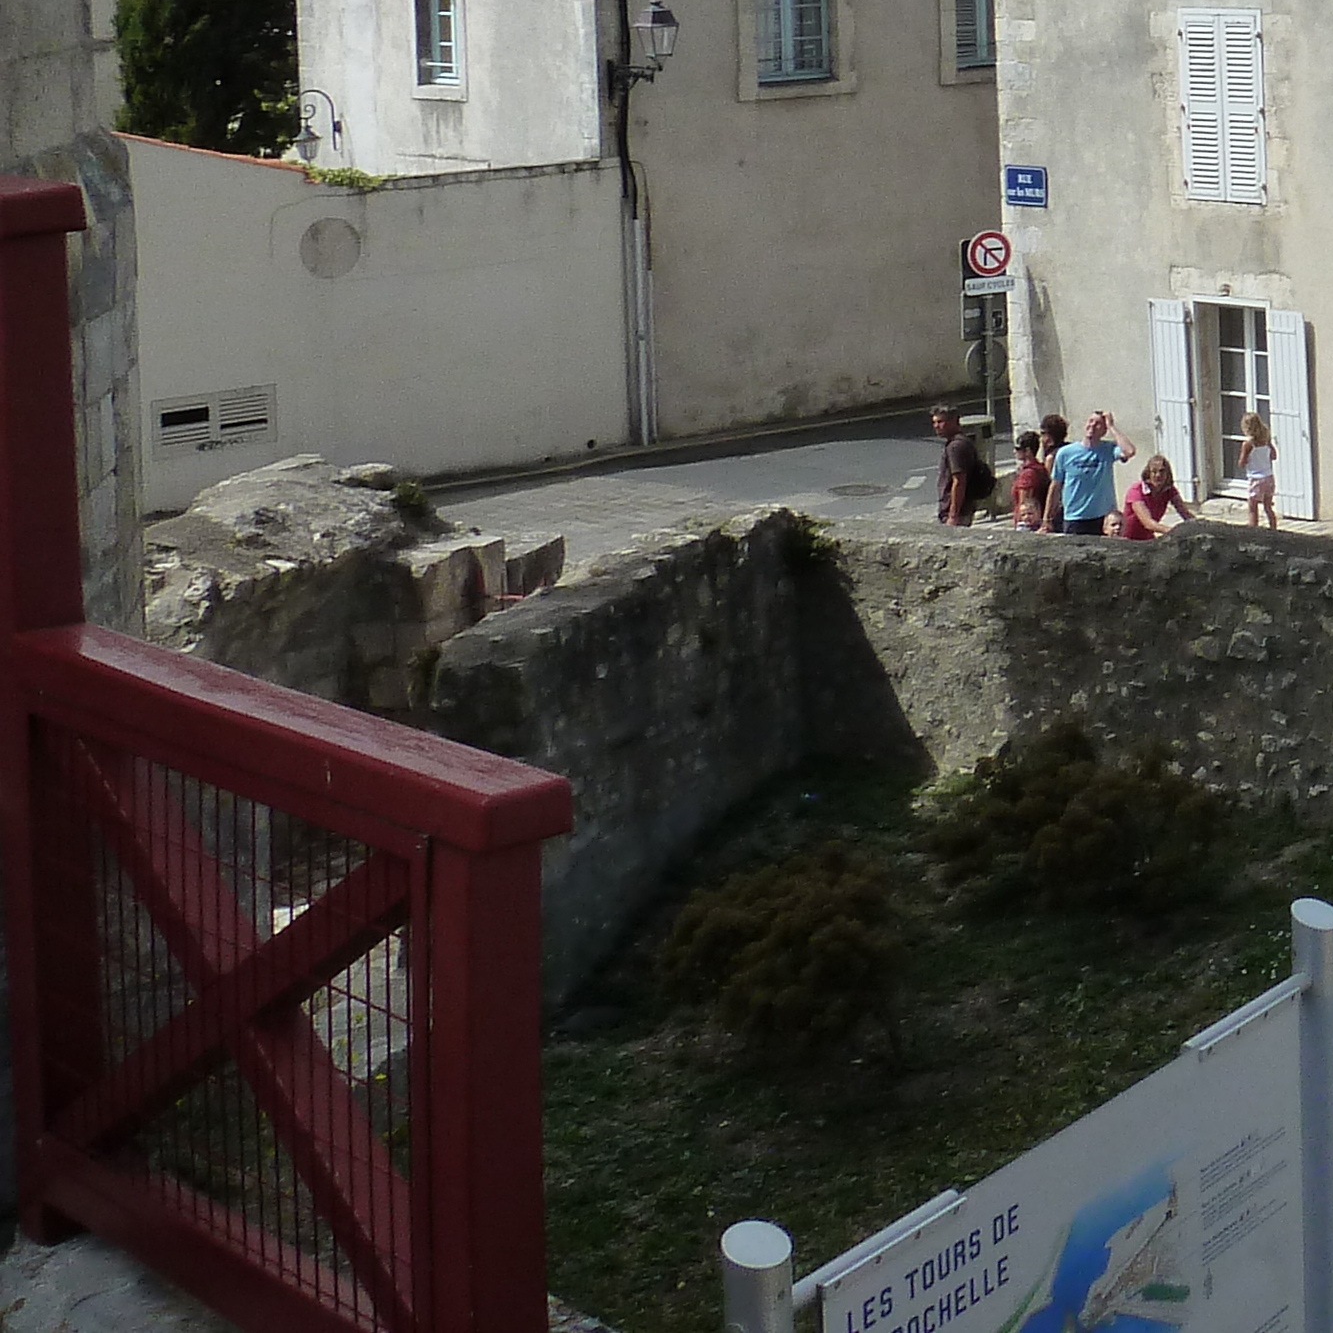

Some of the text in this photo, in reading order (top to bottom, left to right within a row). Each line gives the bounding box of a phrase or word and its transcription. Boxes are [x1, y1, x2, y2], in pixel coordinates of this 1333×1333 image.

[1017, 173, 1033, 184] RUE
[966, 277, 1015, 291] SAUF CYCLES
[846, 1202, 1020, 1333] LES TOURS DE
[891, 1255, 1010, 1333] OCHELLE
